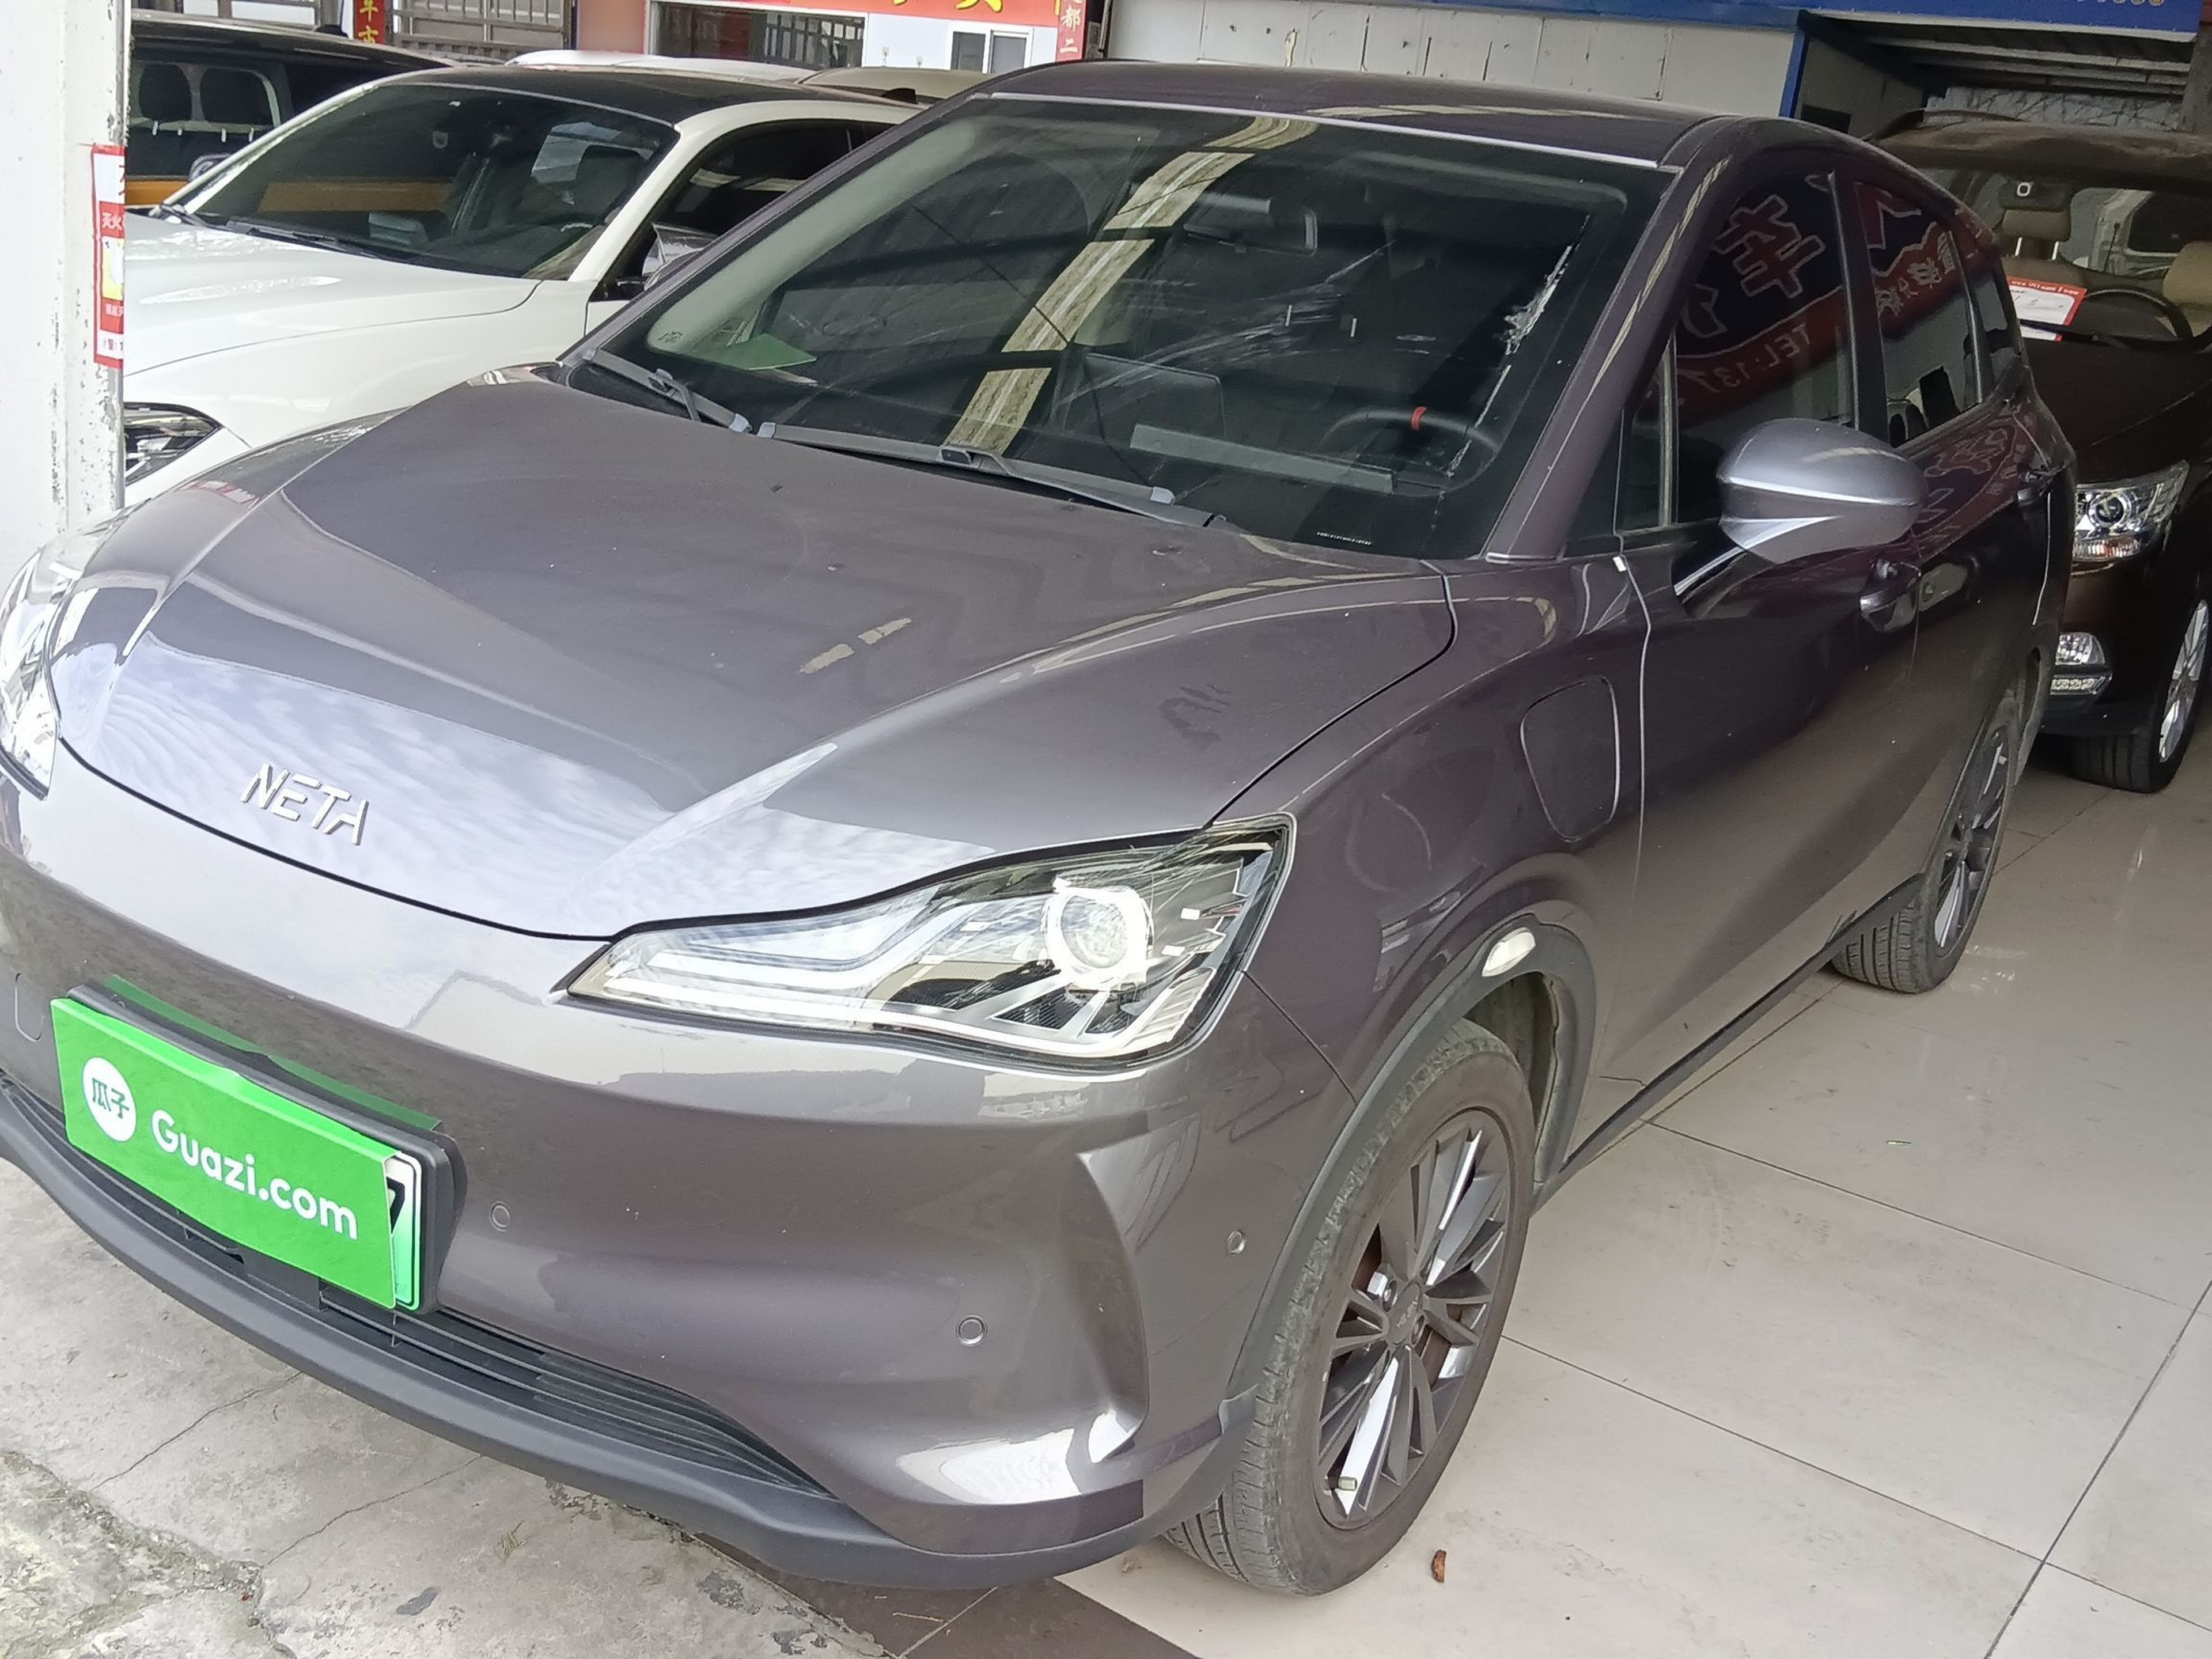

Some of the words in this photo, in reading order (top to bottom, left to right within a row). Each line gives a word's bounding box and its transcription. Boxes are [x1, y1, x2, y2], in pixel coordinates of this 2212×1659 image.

[1060, 0, 1083, 54] 都二
[240, 763, 369, 846] NETA
[92, 1078, 130, 1119] 瓜子
[151, 1109, 358, 1240] Guazi.com
